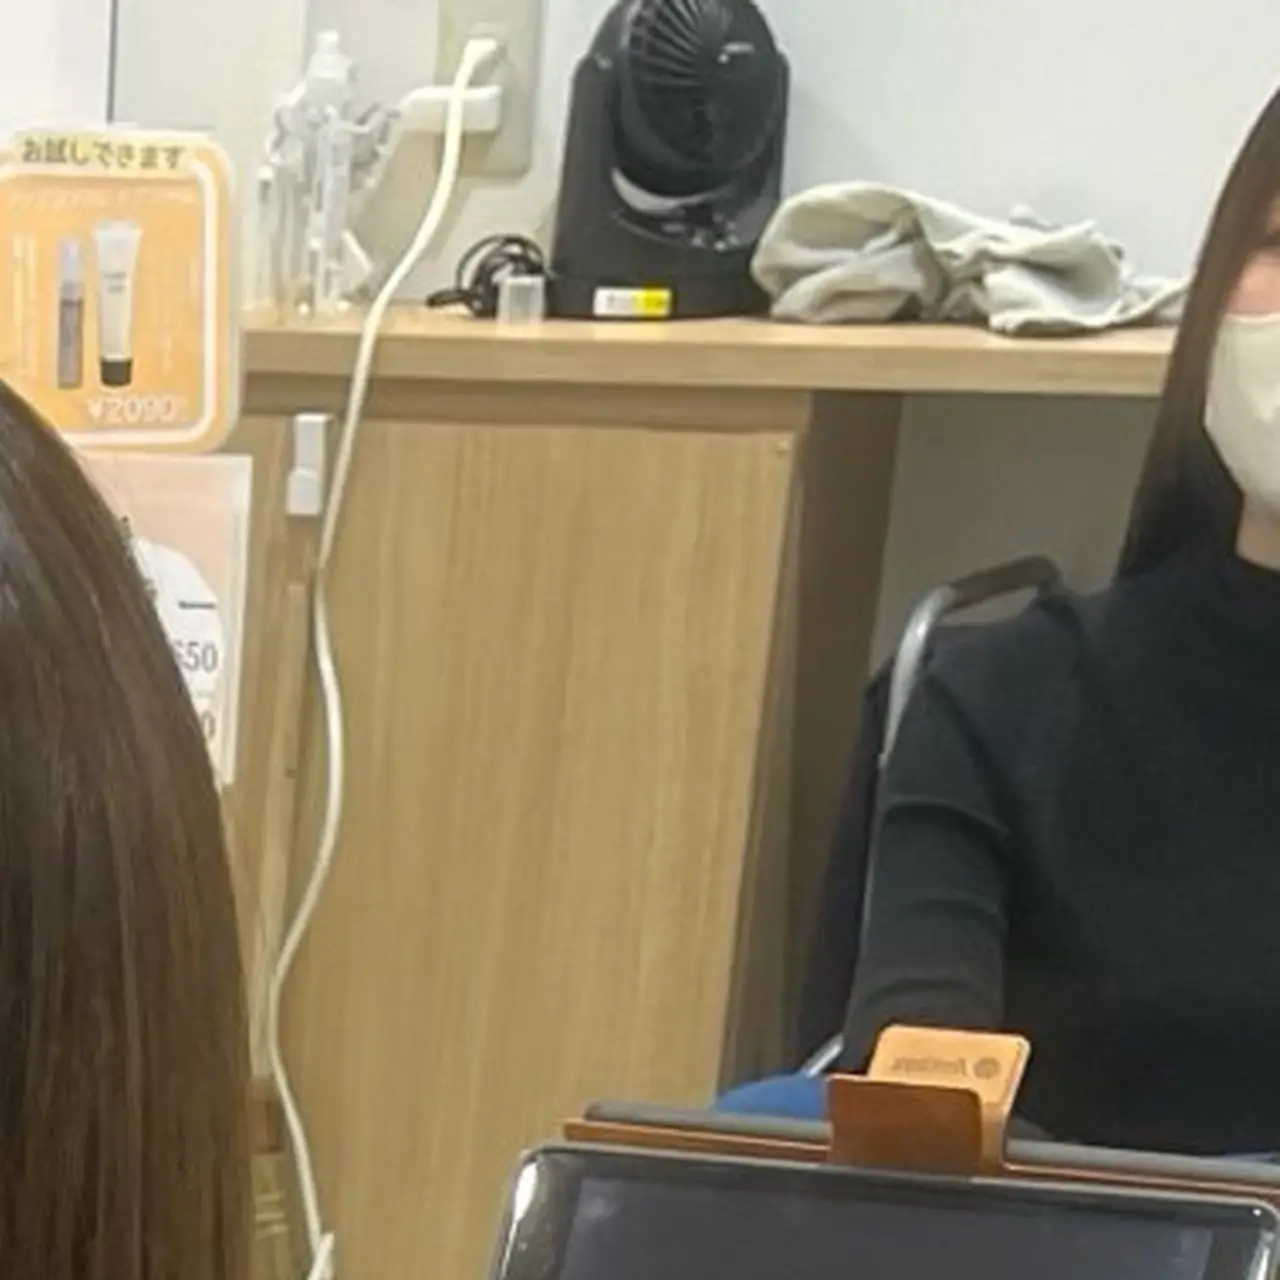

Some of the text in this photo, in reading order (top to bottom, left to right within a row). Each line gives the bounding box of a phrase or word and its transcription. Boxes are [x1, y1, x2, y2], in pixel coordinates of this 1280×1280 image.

[22, 135, 187, 170] お試しできます
